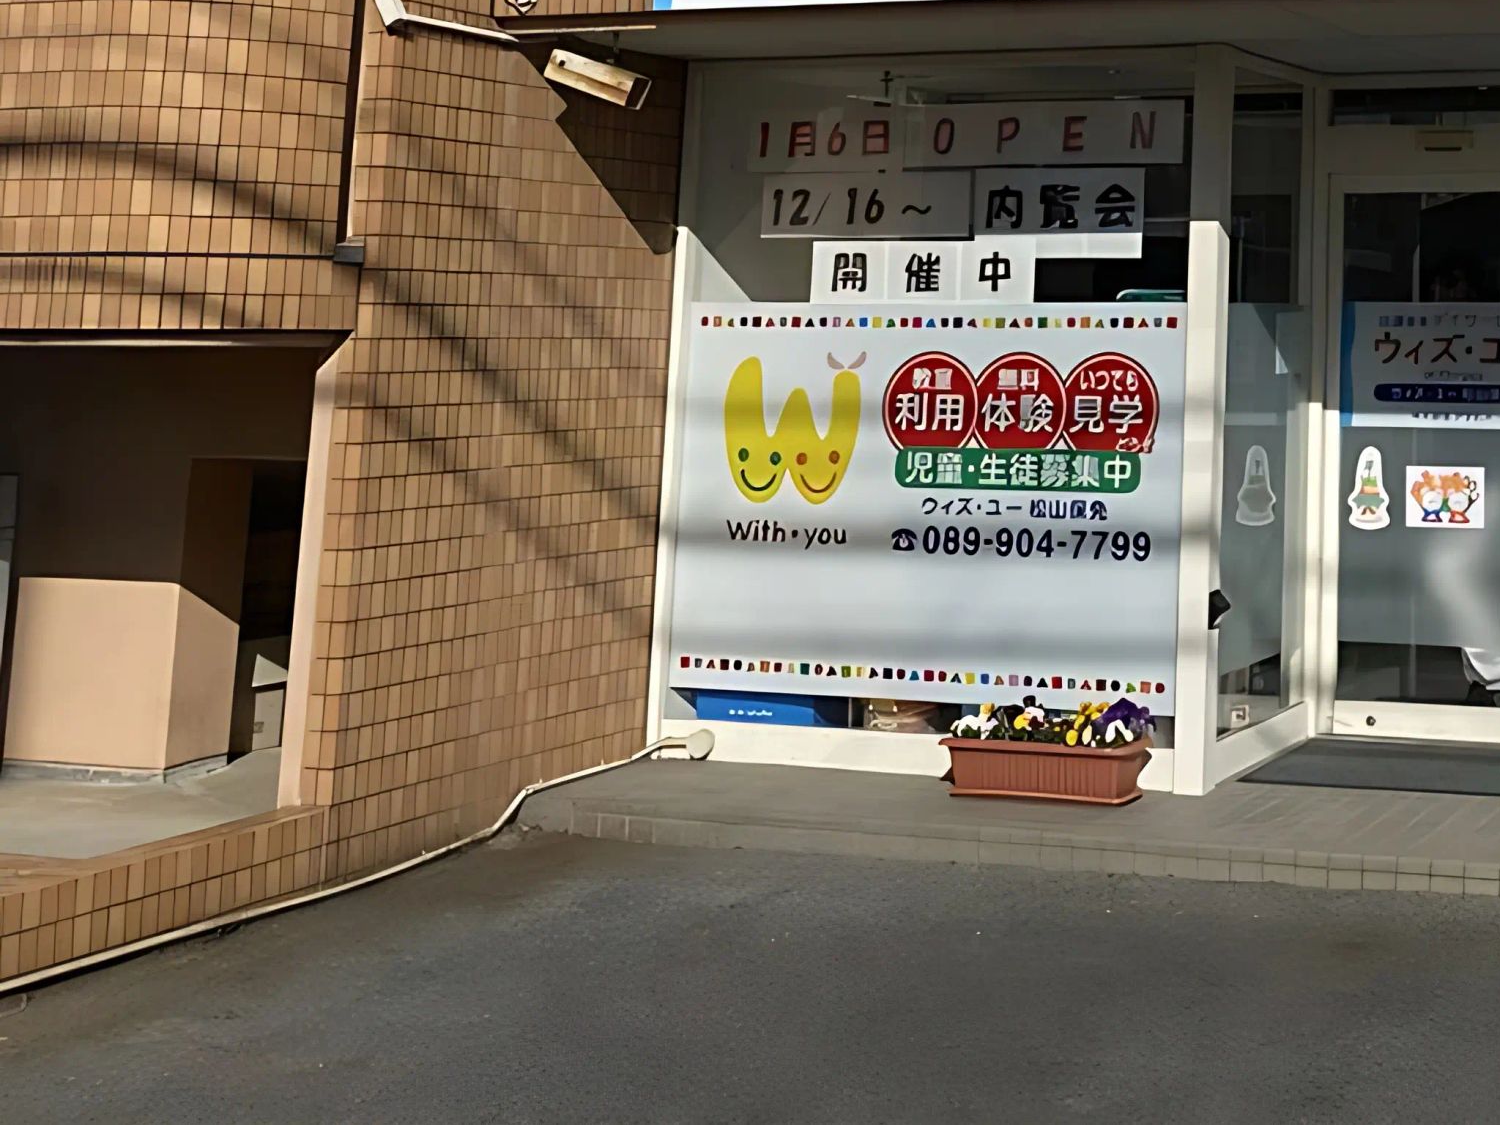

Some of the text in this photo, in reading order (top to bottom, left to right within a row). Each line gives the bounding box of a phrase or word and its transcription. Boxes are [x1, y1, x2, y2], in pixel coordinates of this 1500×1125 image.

[932, 110, 1158, 157] OPEN
[984, 183, 1136, 230] 内覧会
[830, 251, 1013, 294] 開催中
[894, 392, 966, 432] 利用
[980, 392, 1055, 434] 体験
[1069, 393, 1144, 434] 見学
[922, 525, 1152, 562] 089-904-7799
